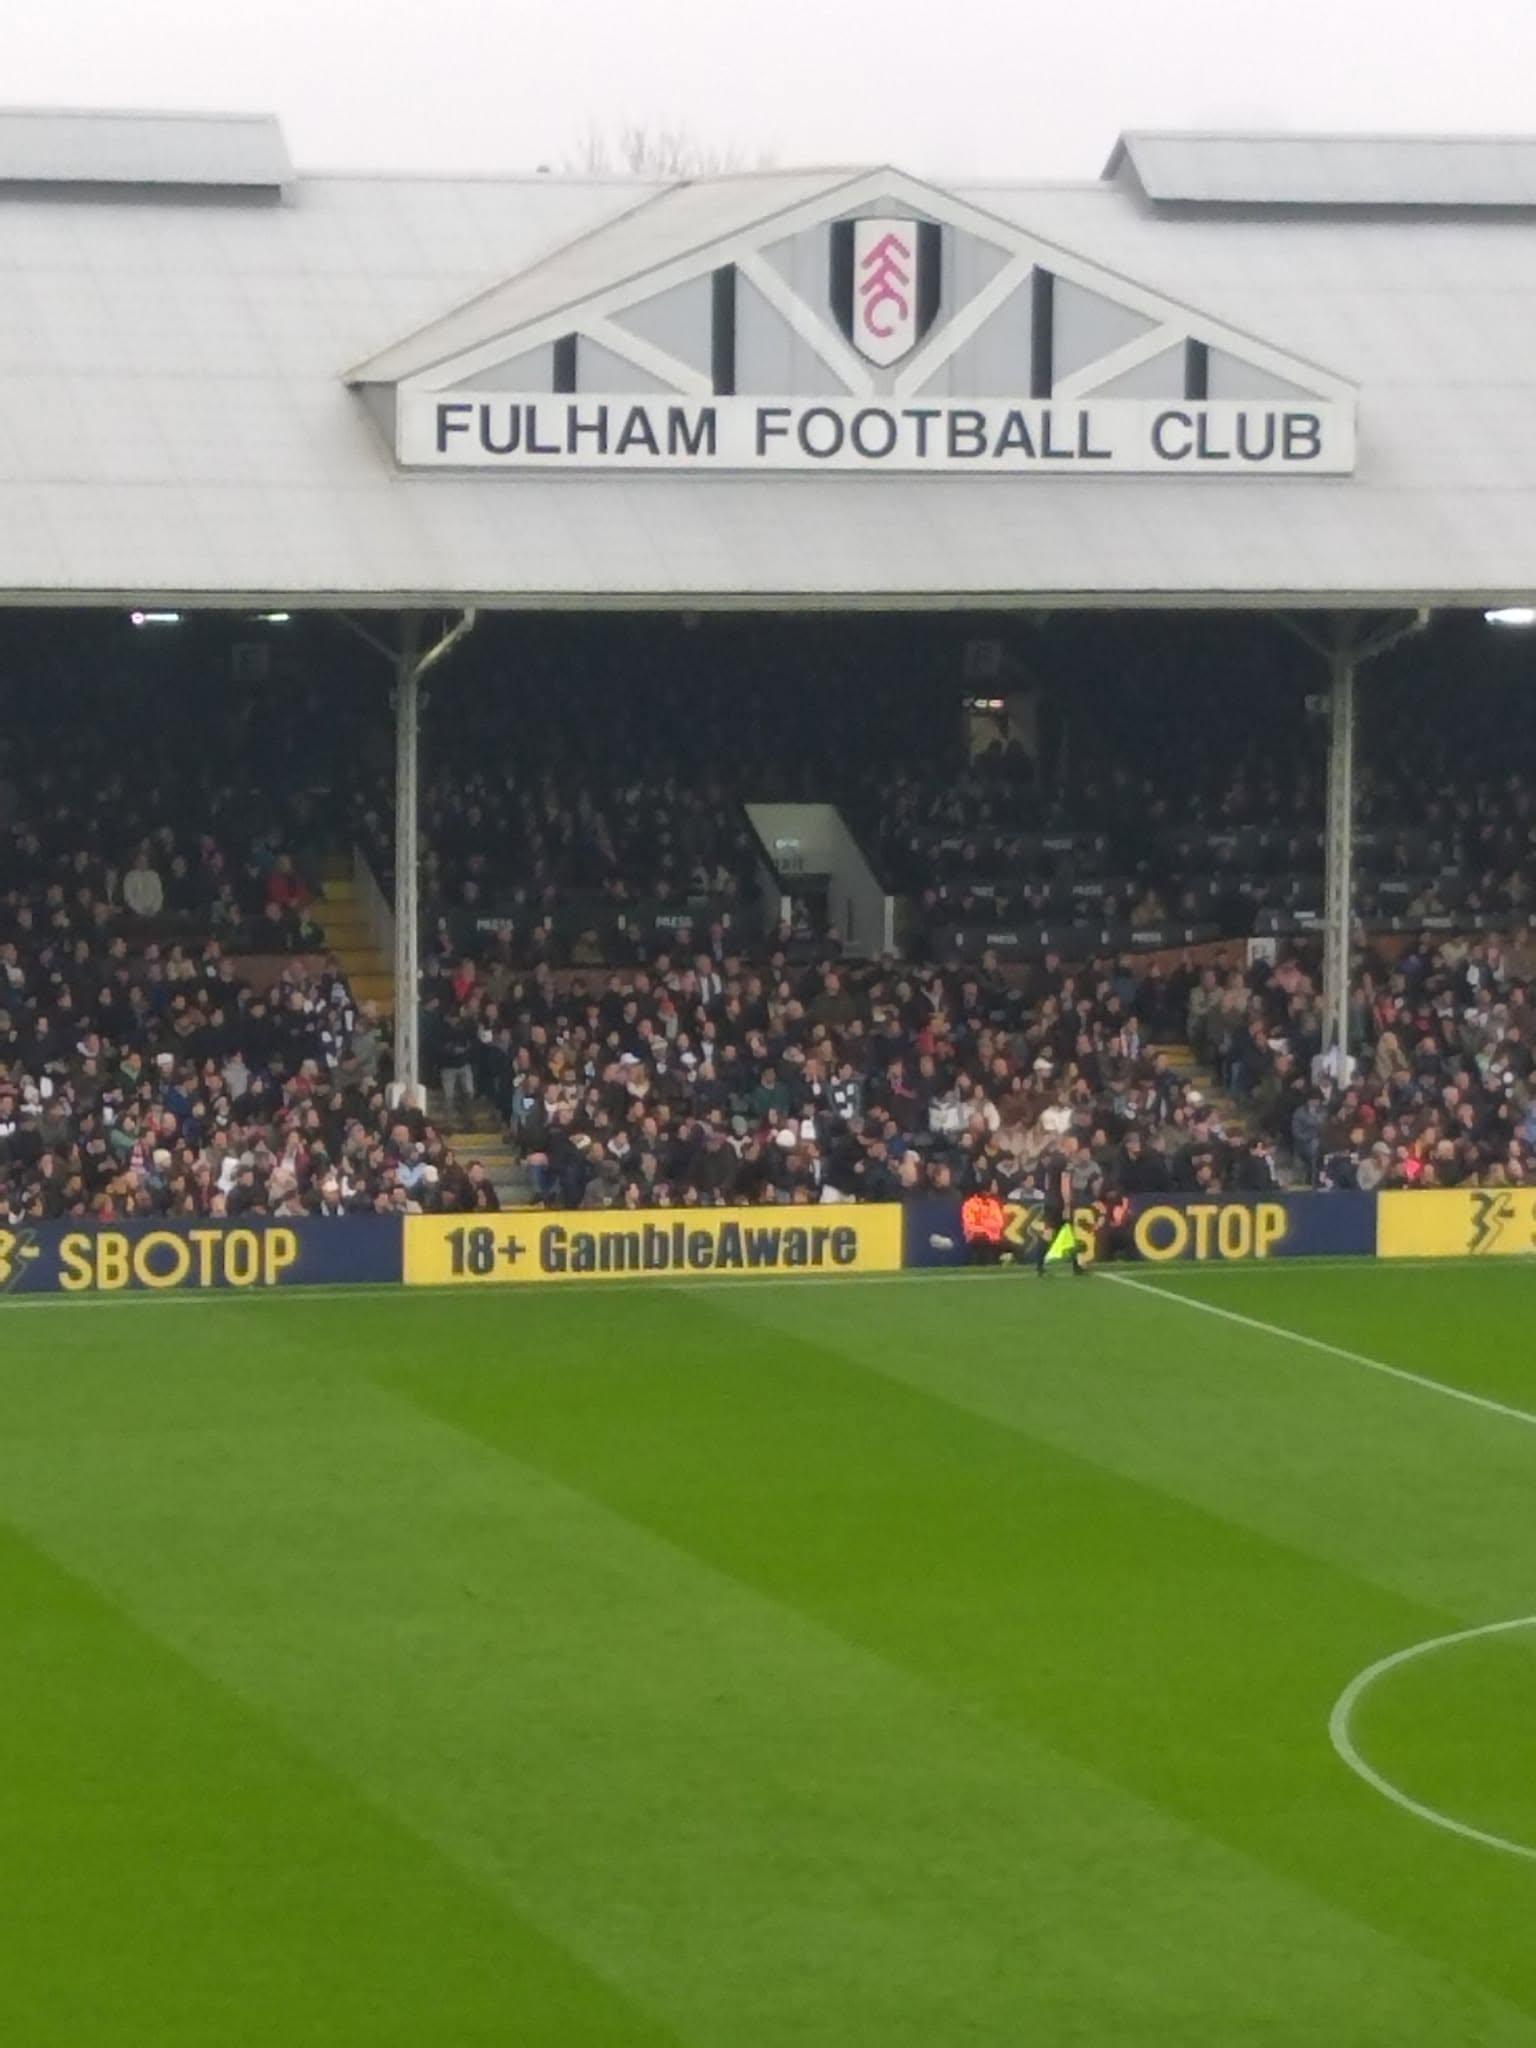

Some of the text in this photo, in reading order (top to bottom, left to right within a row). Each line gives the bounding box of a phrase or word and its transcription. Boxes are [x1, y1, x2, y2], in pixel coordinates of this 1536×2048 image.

[436, 403, 1322, 462] FULHAM FOOTBALL CLUB
[58, 1228, 297, 1291] SBOTOP
[444, 1221, 858, 1276] 18+ GambleAware
[1072, 1202, 1287, 1265] SOTOP
